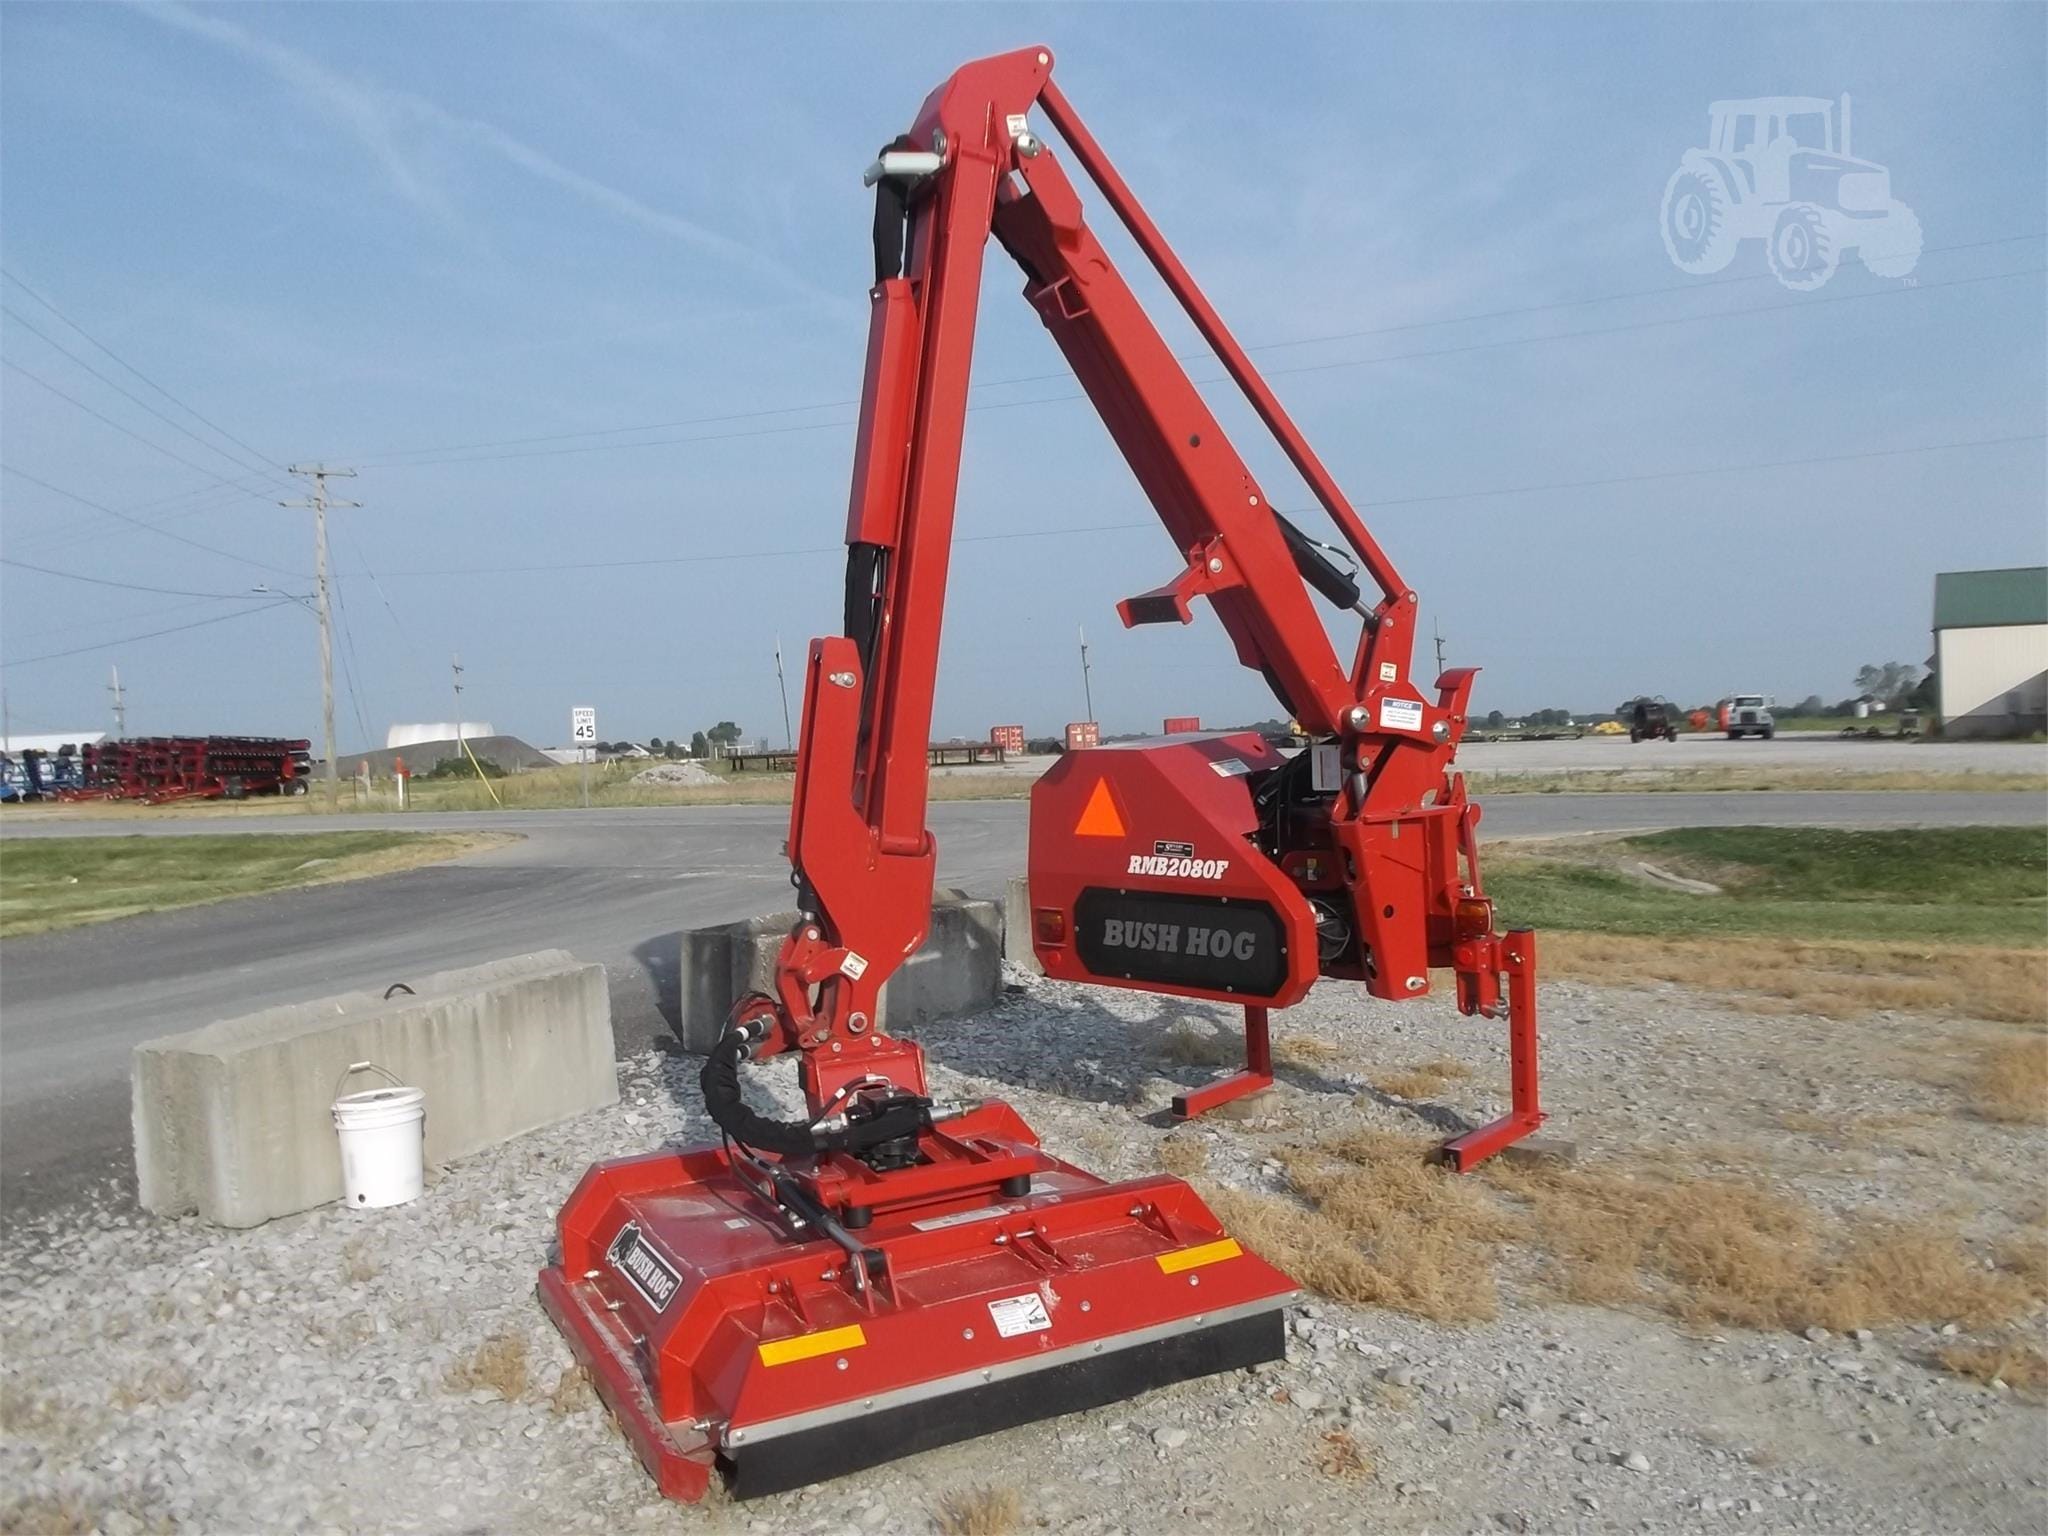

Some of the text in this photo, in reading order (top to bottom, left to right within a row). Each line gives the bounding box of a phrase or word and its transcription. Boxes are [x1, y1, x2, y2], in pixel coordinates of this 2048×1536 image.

[1391, 701, 1413, 709] NOTICE
[576, 725, 594, 738] 45
[1127, 855, 1229, 880] RMB2080F
[1103, 919, 1256, 961] BUSH HOG
[626, 1246, 675, 1300] BUSH HOG
